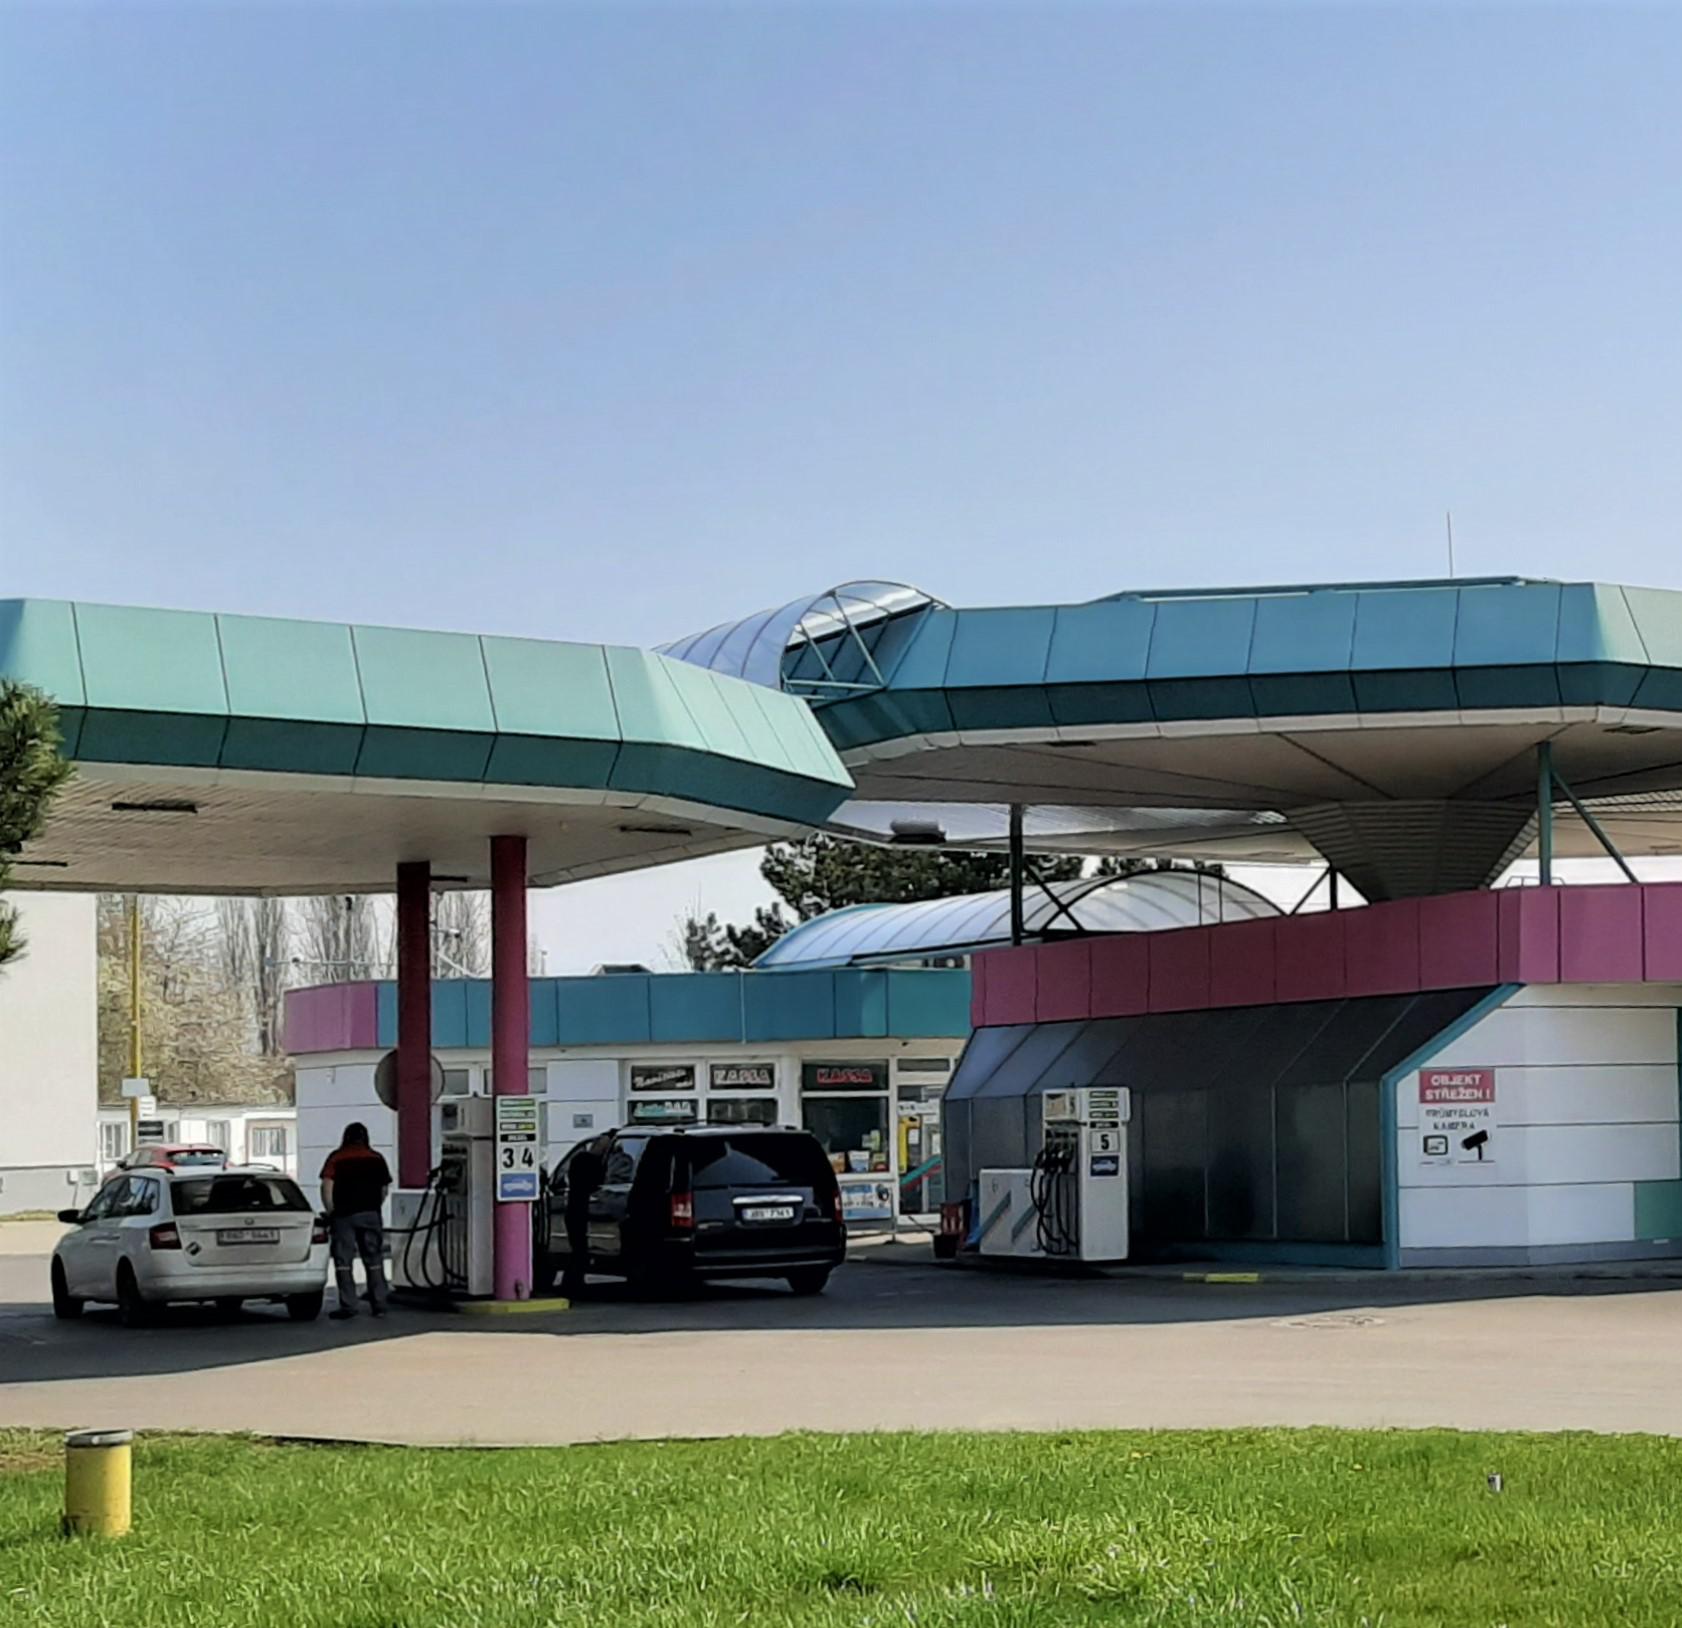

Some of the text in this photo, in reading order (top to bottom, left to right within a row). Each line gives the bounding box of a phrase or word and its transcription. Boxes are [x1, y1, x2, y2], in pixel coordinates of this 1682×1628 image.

[816, 1068, 873, 1084] KASSA
[1430, 1074, 1482, 1086] OBJEKT
[1433, 1121, 1475, 1130] KAMERA
[1101, 1134, 1110, 1150] 5
